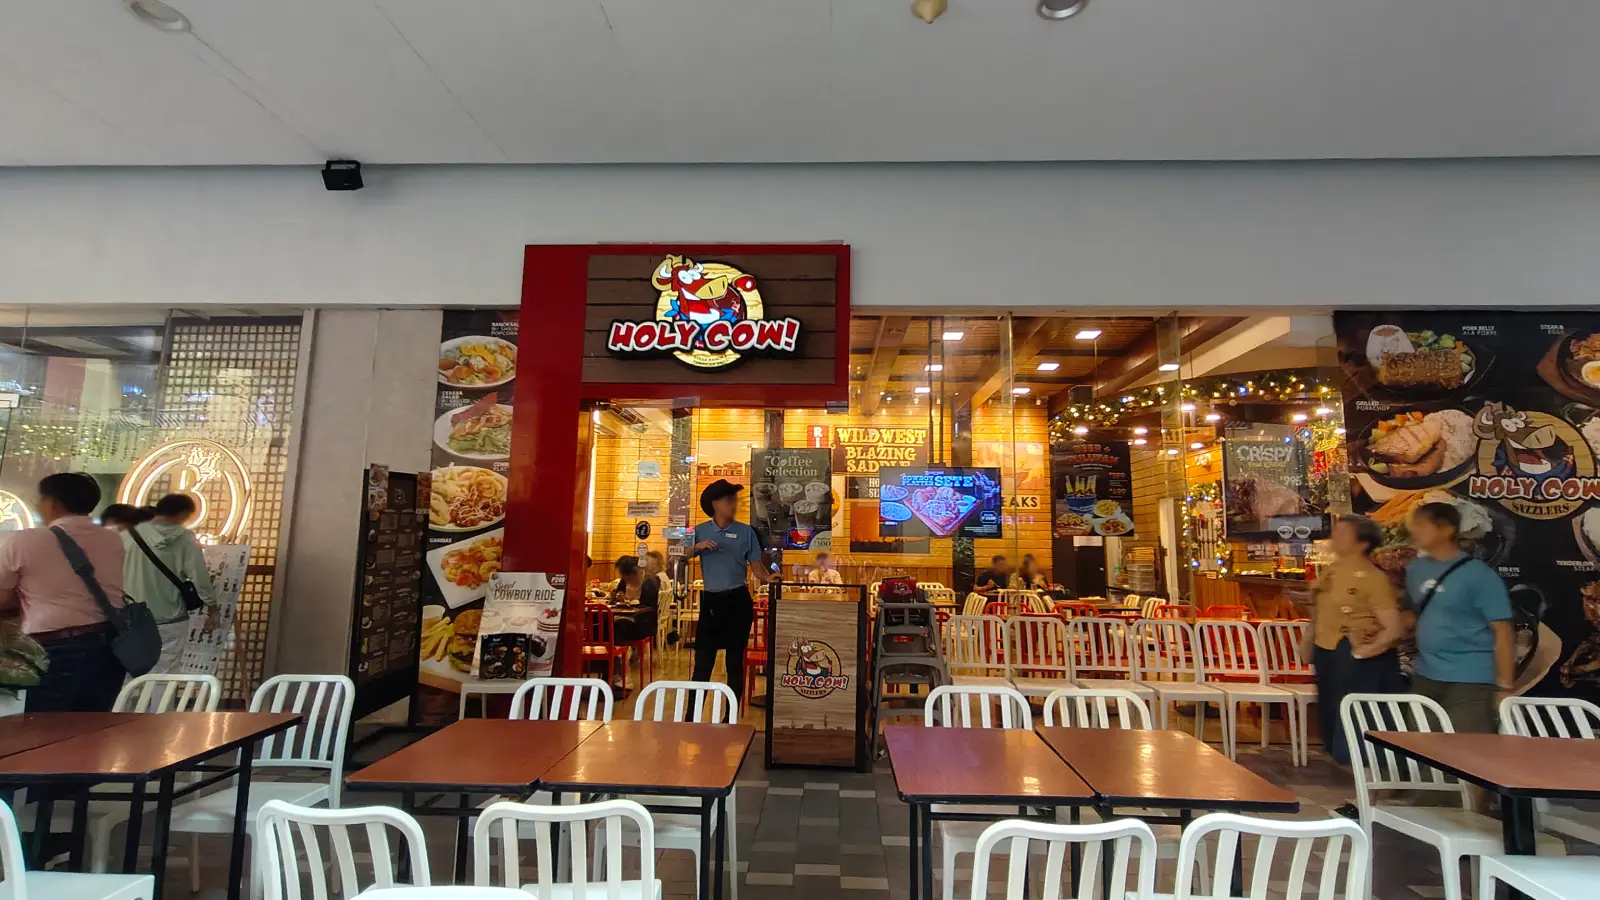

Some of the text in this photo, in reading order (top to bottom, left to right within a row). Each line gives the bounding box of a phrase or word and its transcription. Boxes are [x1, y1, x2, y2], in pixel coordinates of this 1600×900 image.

[608, 317, 801, 352] HOLY COW!
[837, 428, 926, 444] WILD WEST
[845, 446, 916, 460] BLAZING
[1236, 445, 1294, 462] CRISPY
[771, 455, 812, 467] Coffee
[765, 466, 817, 477] Selection
[1469, 476, 1537, 499] HOLY
[1512, 503, 1570, 515] SIZZLERS
[494, 590, 556, 600] COWBOY RIDE
[782, 675, 849, 689] HOLY COW!
